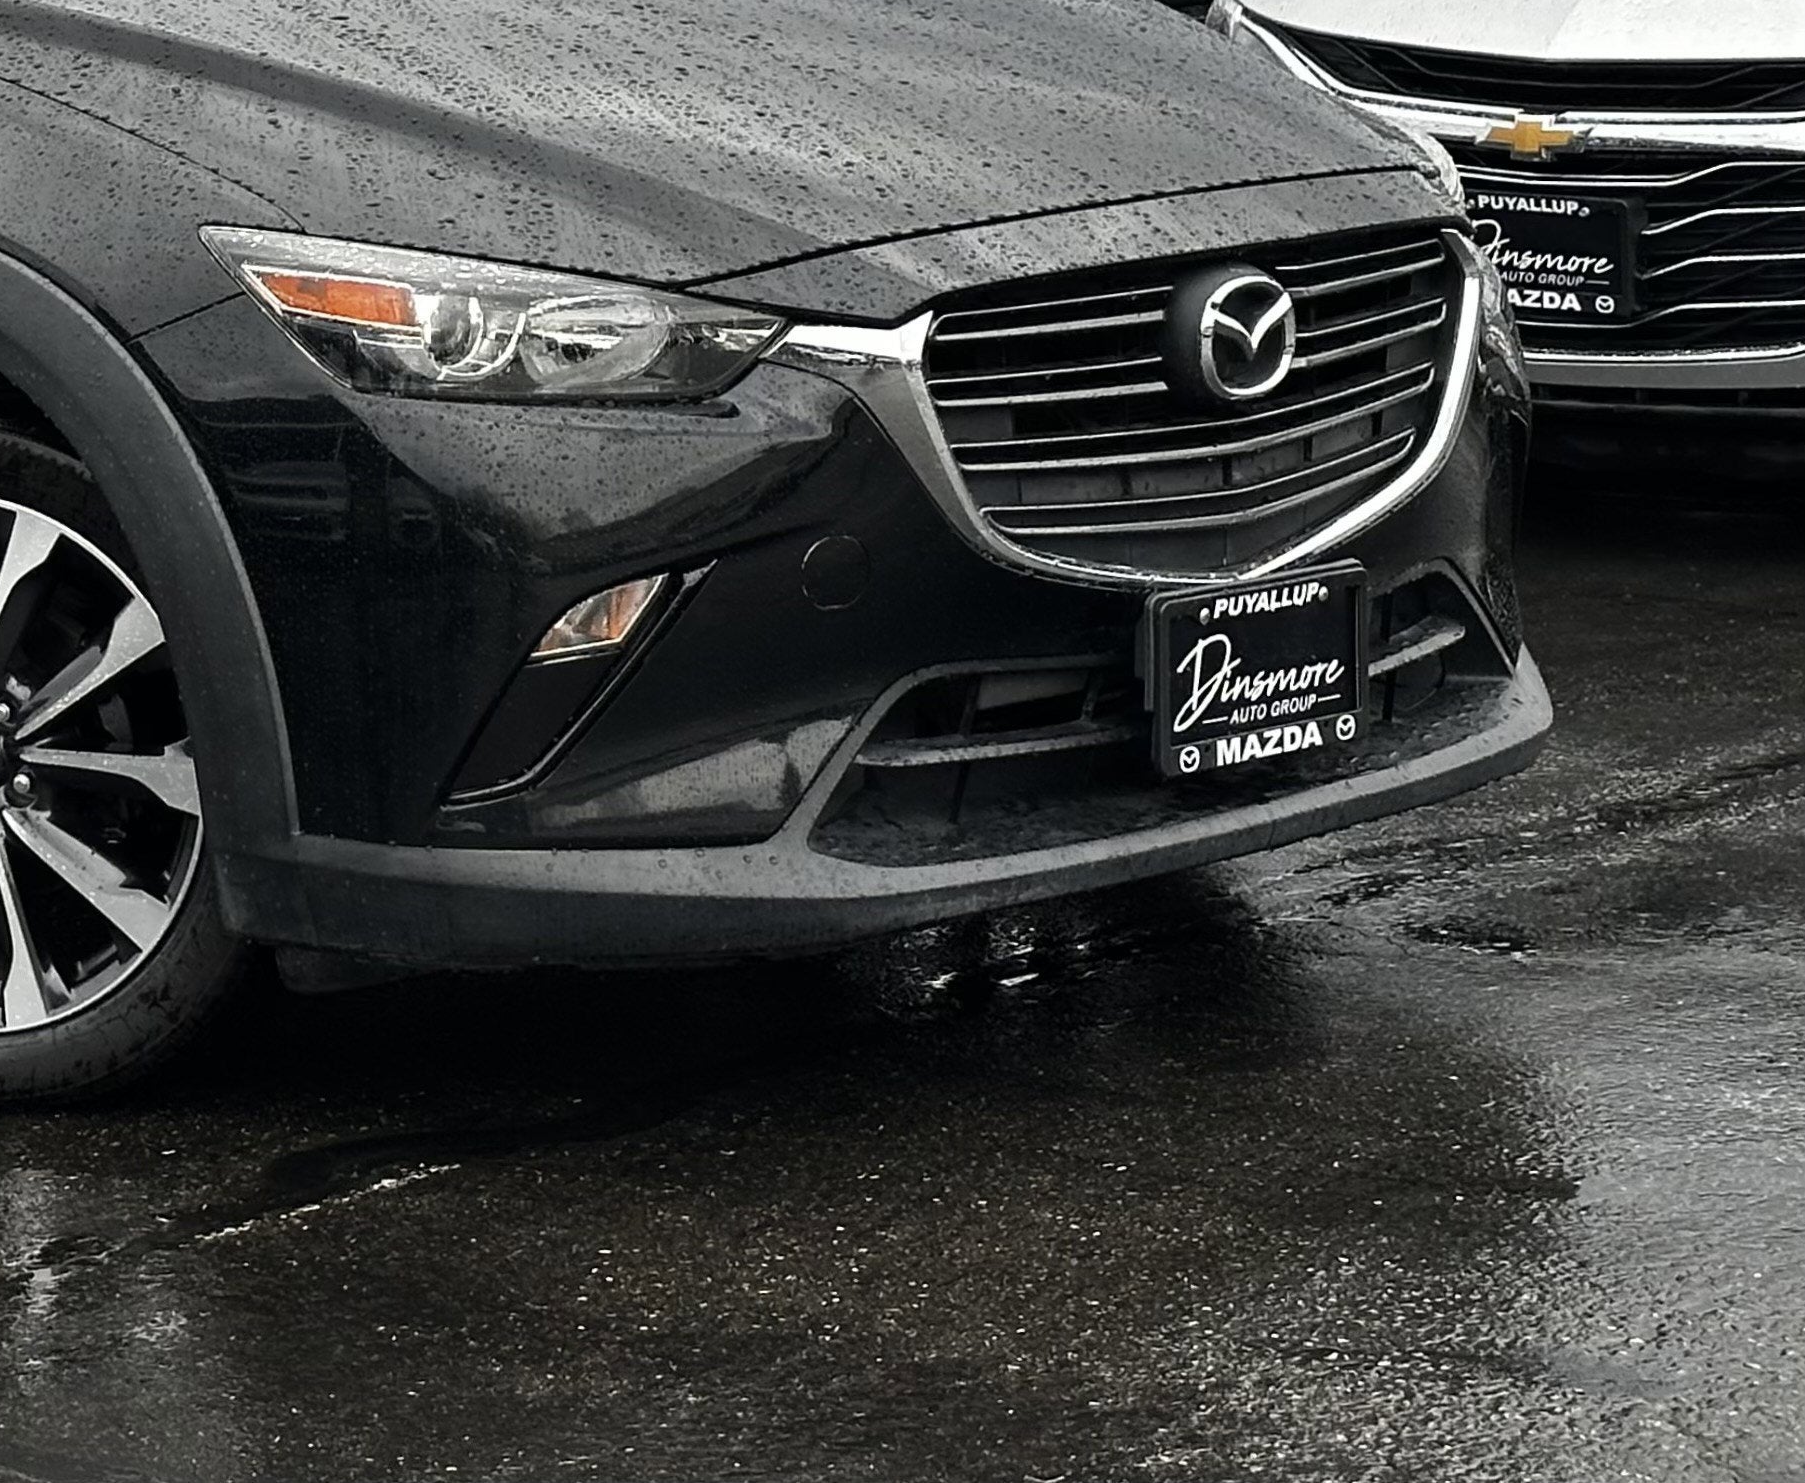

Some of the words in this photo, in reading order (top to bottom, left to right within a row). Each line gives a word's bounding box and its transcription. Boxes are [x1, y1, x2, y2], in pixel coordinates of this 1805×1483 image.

[1477, 194, 1580, 215] PUYALLUP
[1501, 271, 1535, 283] AUTO
[1538, 273, 1585, 287] GROUP
[1507, 288, 1582, 312] AZDA
[1212, 581, 1321, 619] PUYALLUP
[1173, 633, 1345, 734] Dinsmore
[1230, 706, 1268, 725] AUTO
[1270, 693, 1317, 718] GROUP
[1216, 720, 1323, 767] MAZDA
